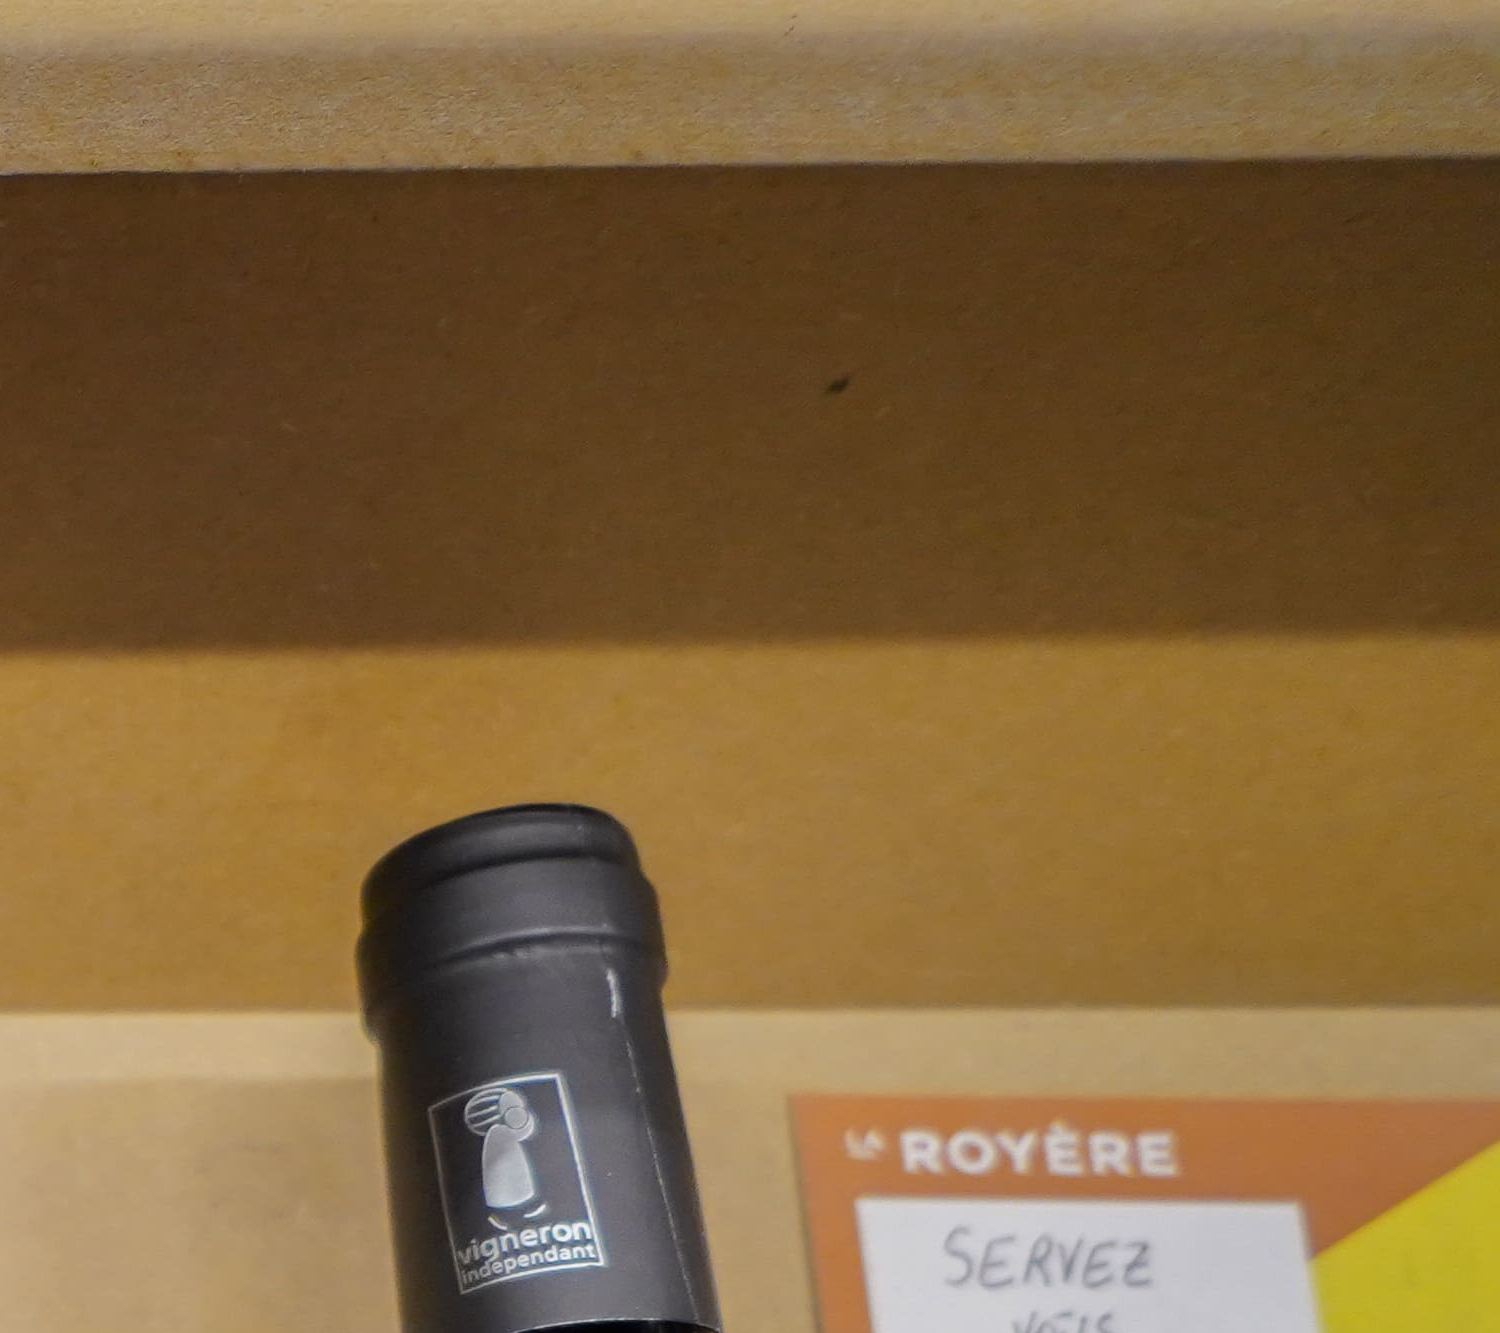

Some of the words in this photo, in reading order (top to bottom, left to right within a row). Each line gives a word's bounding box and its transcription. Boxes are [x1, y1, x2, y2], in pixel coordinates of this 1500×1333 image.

[901, 1124, 1177, 1176] ROYÈRE
[457, 1221, 592, 1264] vigneron
[942, 1227, 1154, 1289] SERVEZ
